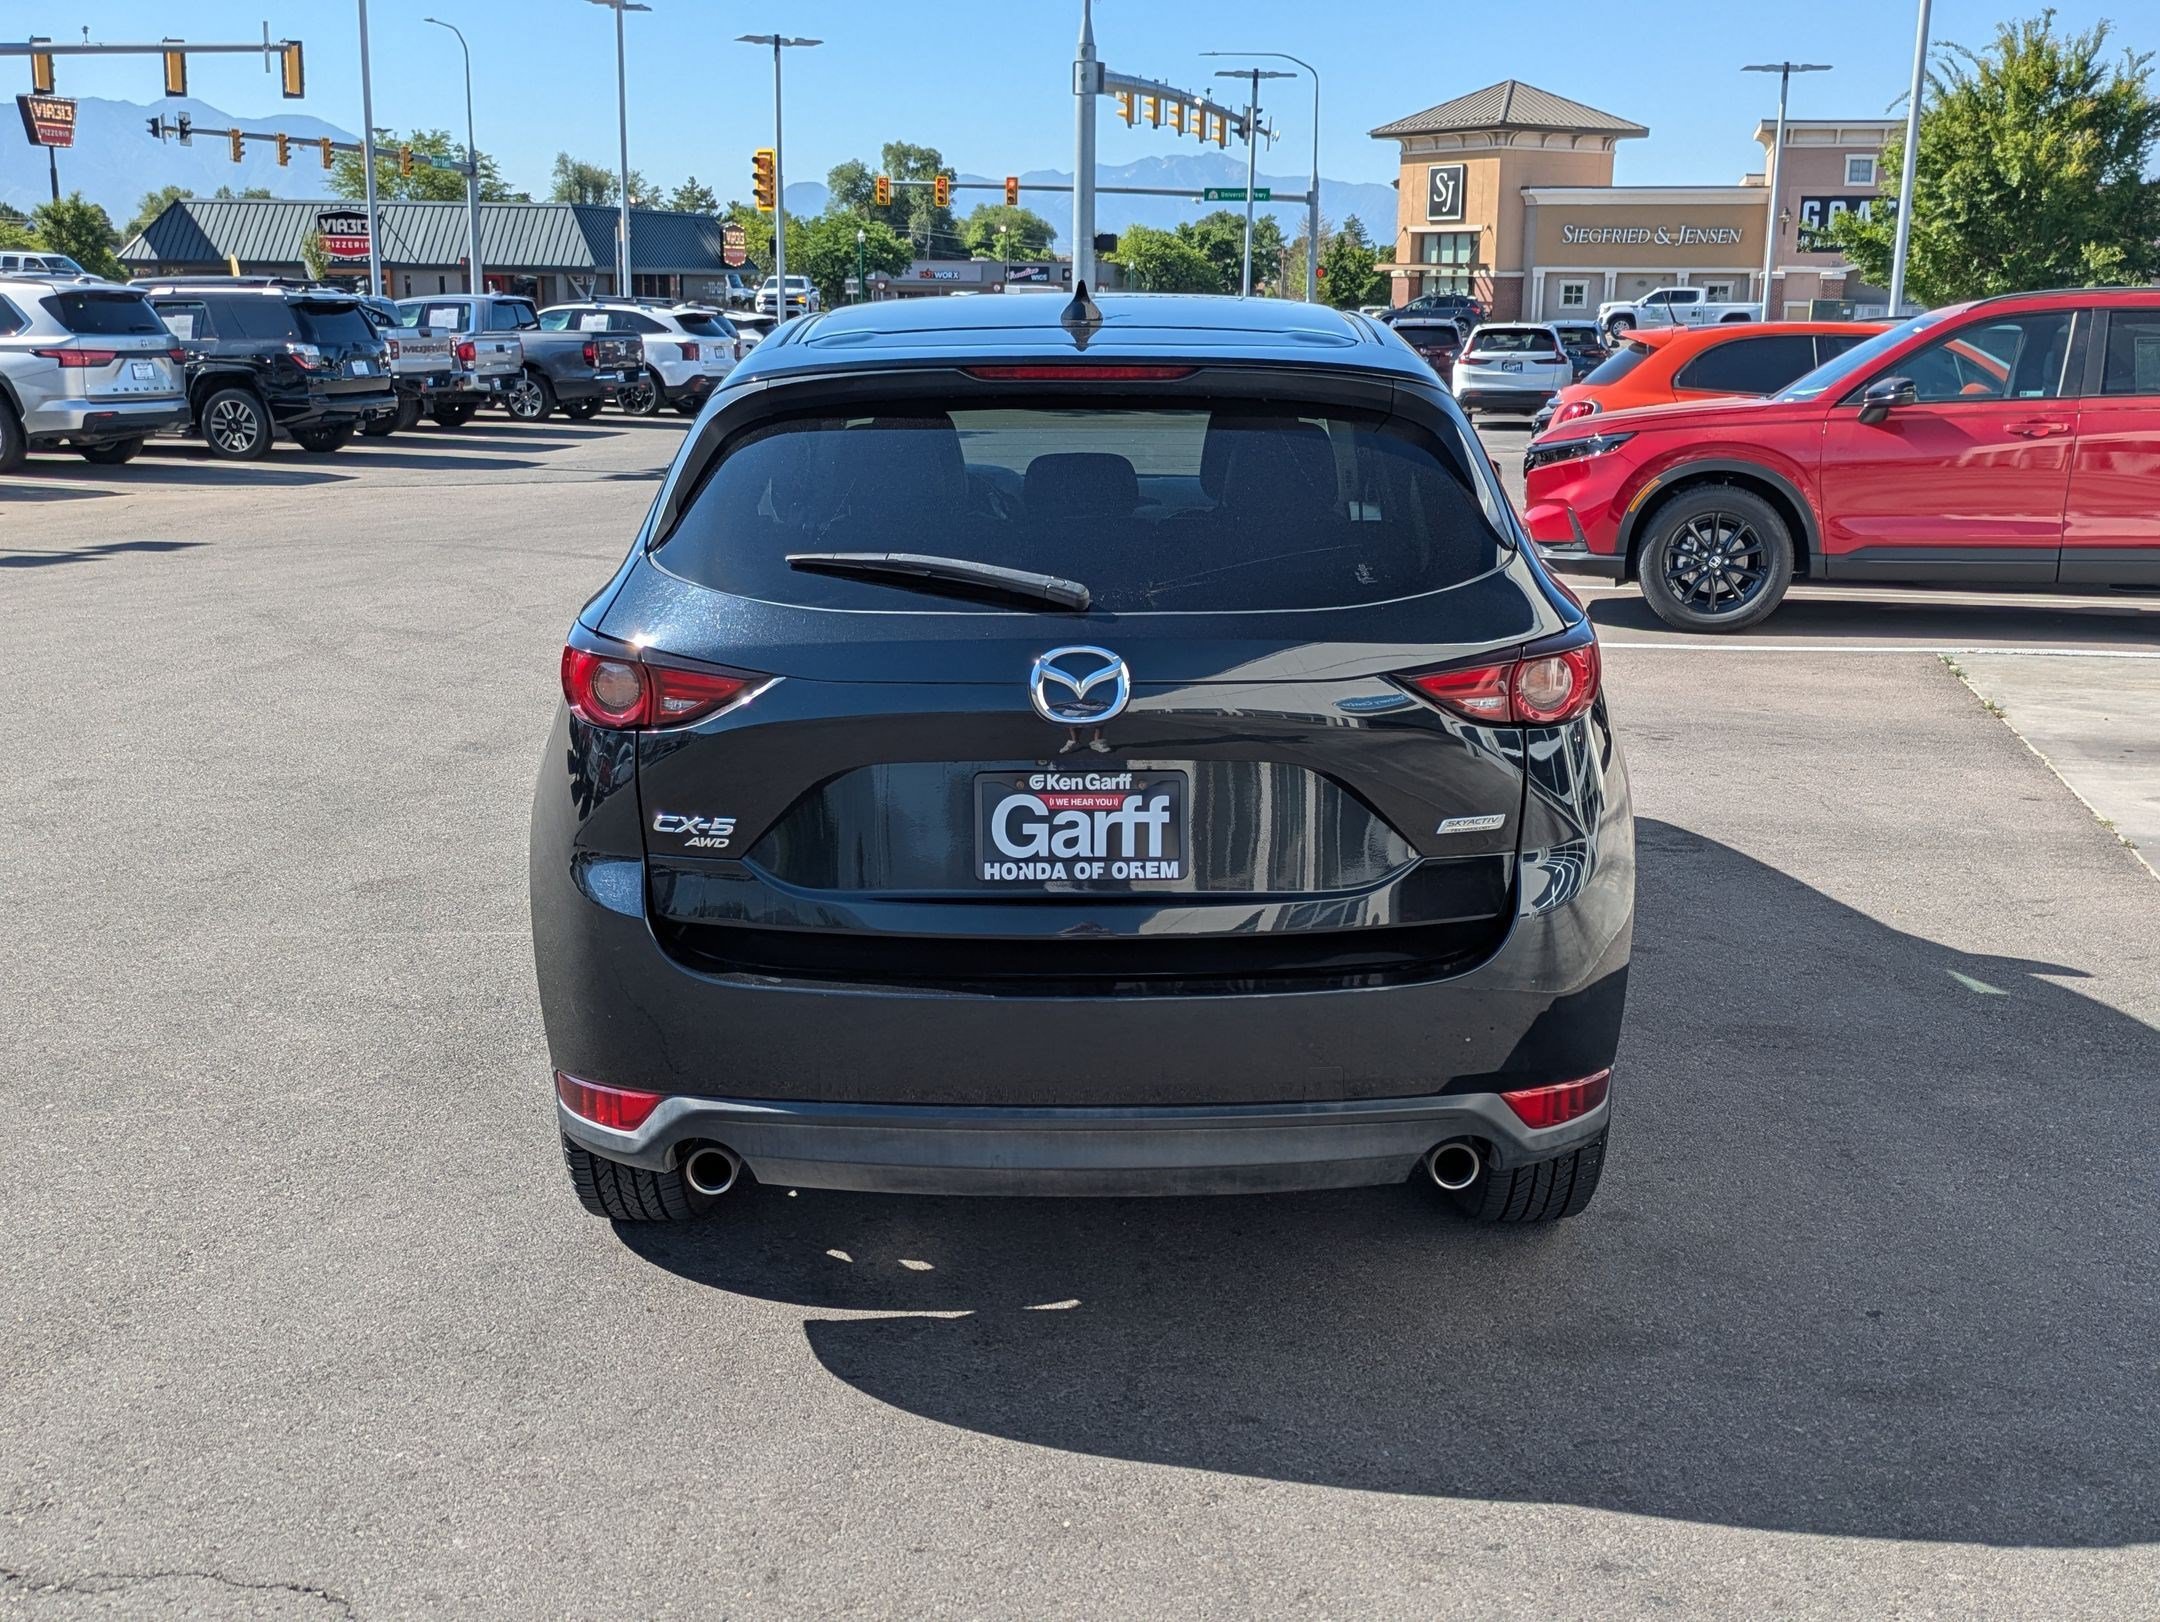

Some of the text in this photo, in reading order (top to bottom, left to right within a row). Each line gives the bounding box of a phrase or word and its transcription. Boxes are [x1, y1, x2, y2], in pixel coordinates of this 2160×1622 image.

[1562, 224, 1743, 246] SIEGFRIED & JENSEN
[1046, 773, 1132, 790] Ken Garff
[1056, 798, 1112, 806] WE HEAR YOU
[653, 814, 737, 836] CX-5
[991, 793, 1170, 859] Garff
[1446, 817, 1499, 827] SKYACTIV
[684, 837, 730, 848] AWD
[984, 860, 1179, 881] HONDA OF OREM
